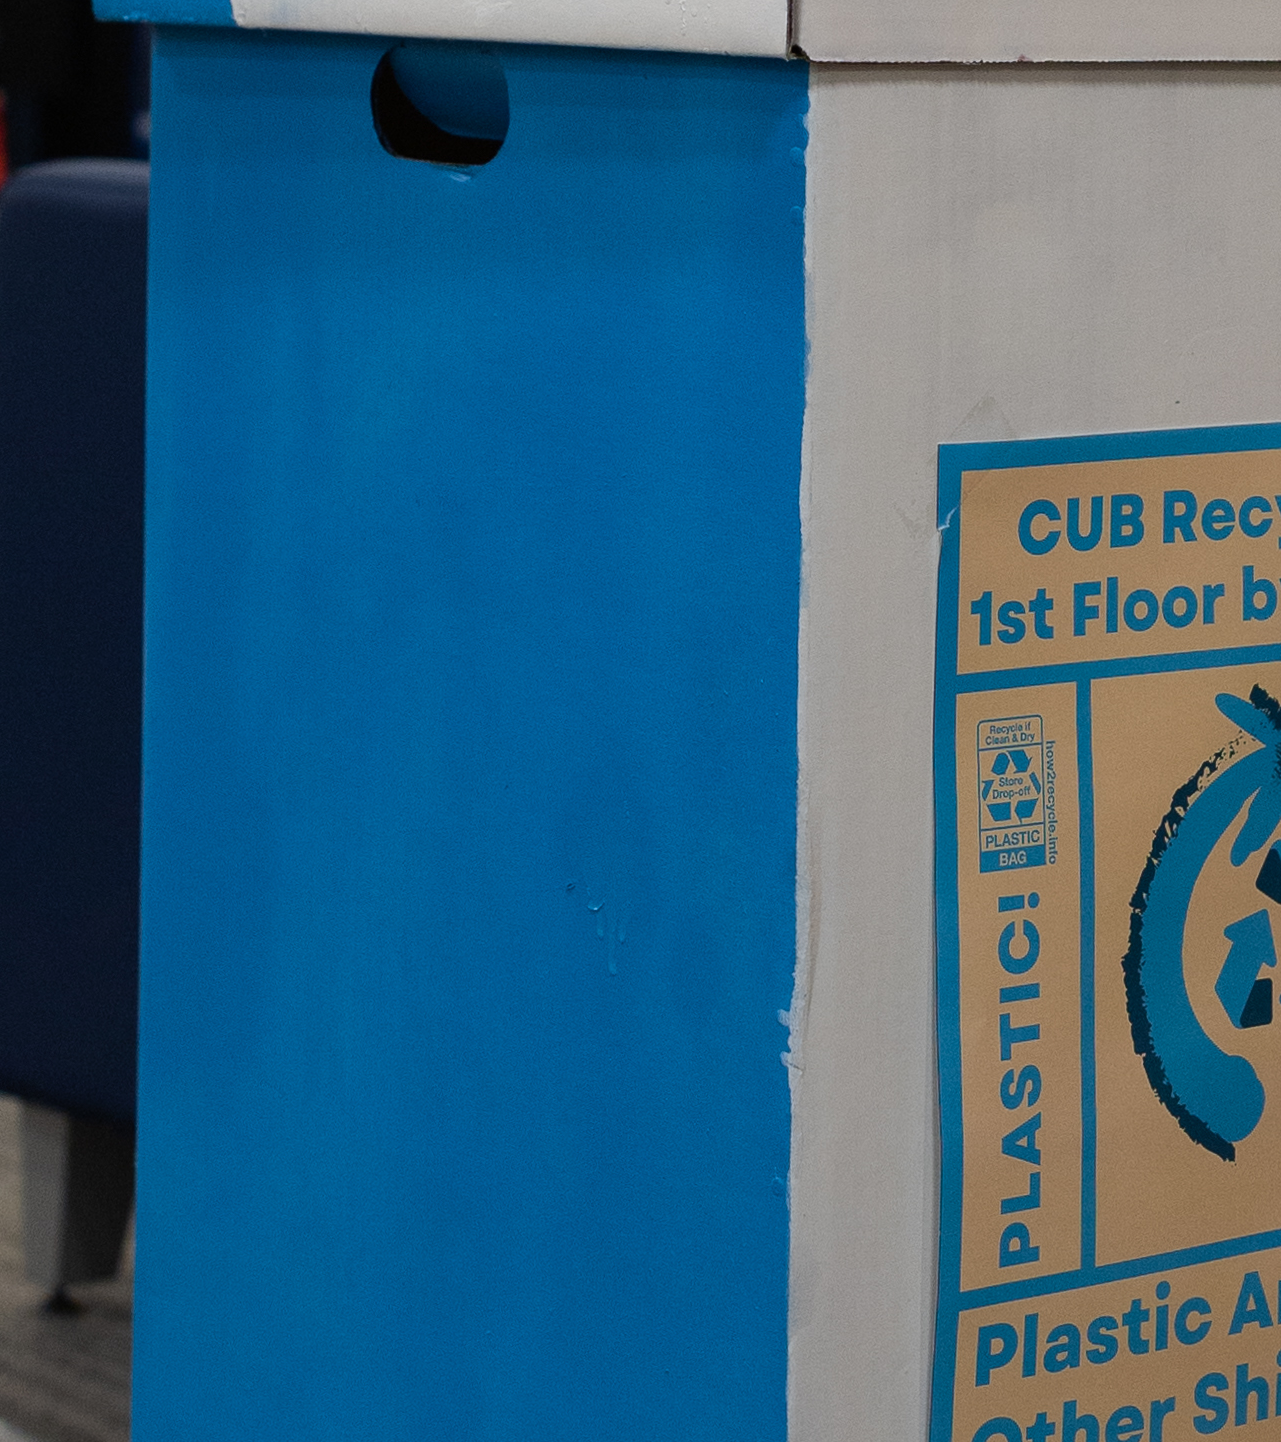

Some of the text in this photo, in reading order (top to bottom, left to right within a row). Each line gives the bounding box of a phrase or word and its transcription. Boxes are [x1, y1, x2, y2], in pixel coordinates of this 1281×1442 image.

[1019, 494, 1144, 555] CUB
[970, 588, 1056, 645] 1st
[1073, 577, 1226, 637] Floor
[1046, 740, 1058, 865] how2recycle.info
[986, 829, 1040, 849] PLASTIC
[999, 851, 1027, 867] BAG
[998, 893, 1041, 1268] PLASTIC!
[974, 1282, 1213, 1386] Plastic
